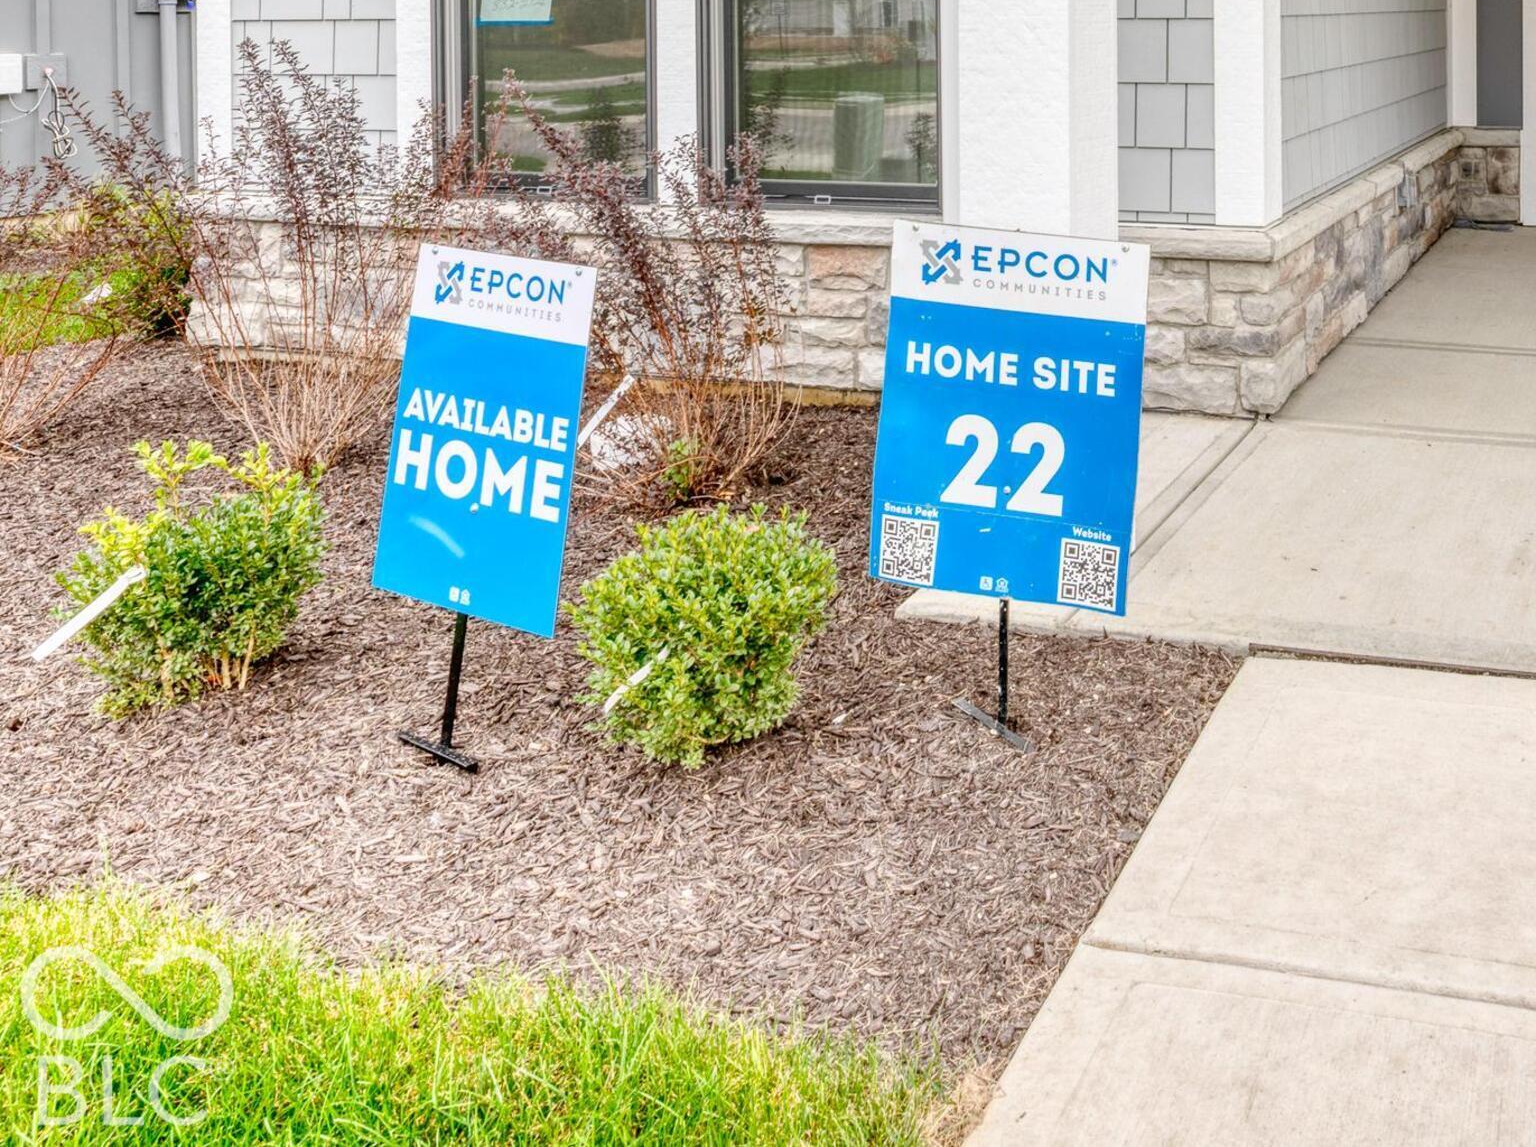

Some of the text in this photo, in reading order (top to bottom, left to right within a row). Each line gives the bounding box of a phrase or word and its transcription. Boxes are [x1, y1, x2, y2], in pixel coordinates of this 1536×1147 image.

[970, 245, 1108, 284] EPCON
[470, 267, 565, 305] EPCON
[972, 278, 1107, 301] COMMUNITIES
[468, 298, 562, 322] COMMUNITIES
[905, 340, 1117, 398] HOME SITE
[403, 387, 570, 453] AVAILABLE
[393, 429, 565, 524] HOME
[939, 413, 1066, 518] 22
[884, 502, 939, 519] Sneak Peek
[1072, 525, 1112, 542] Website
